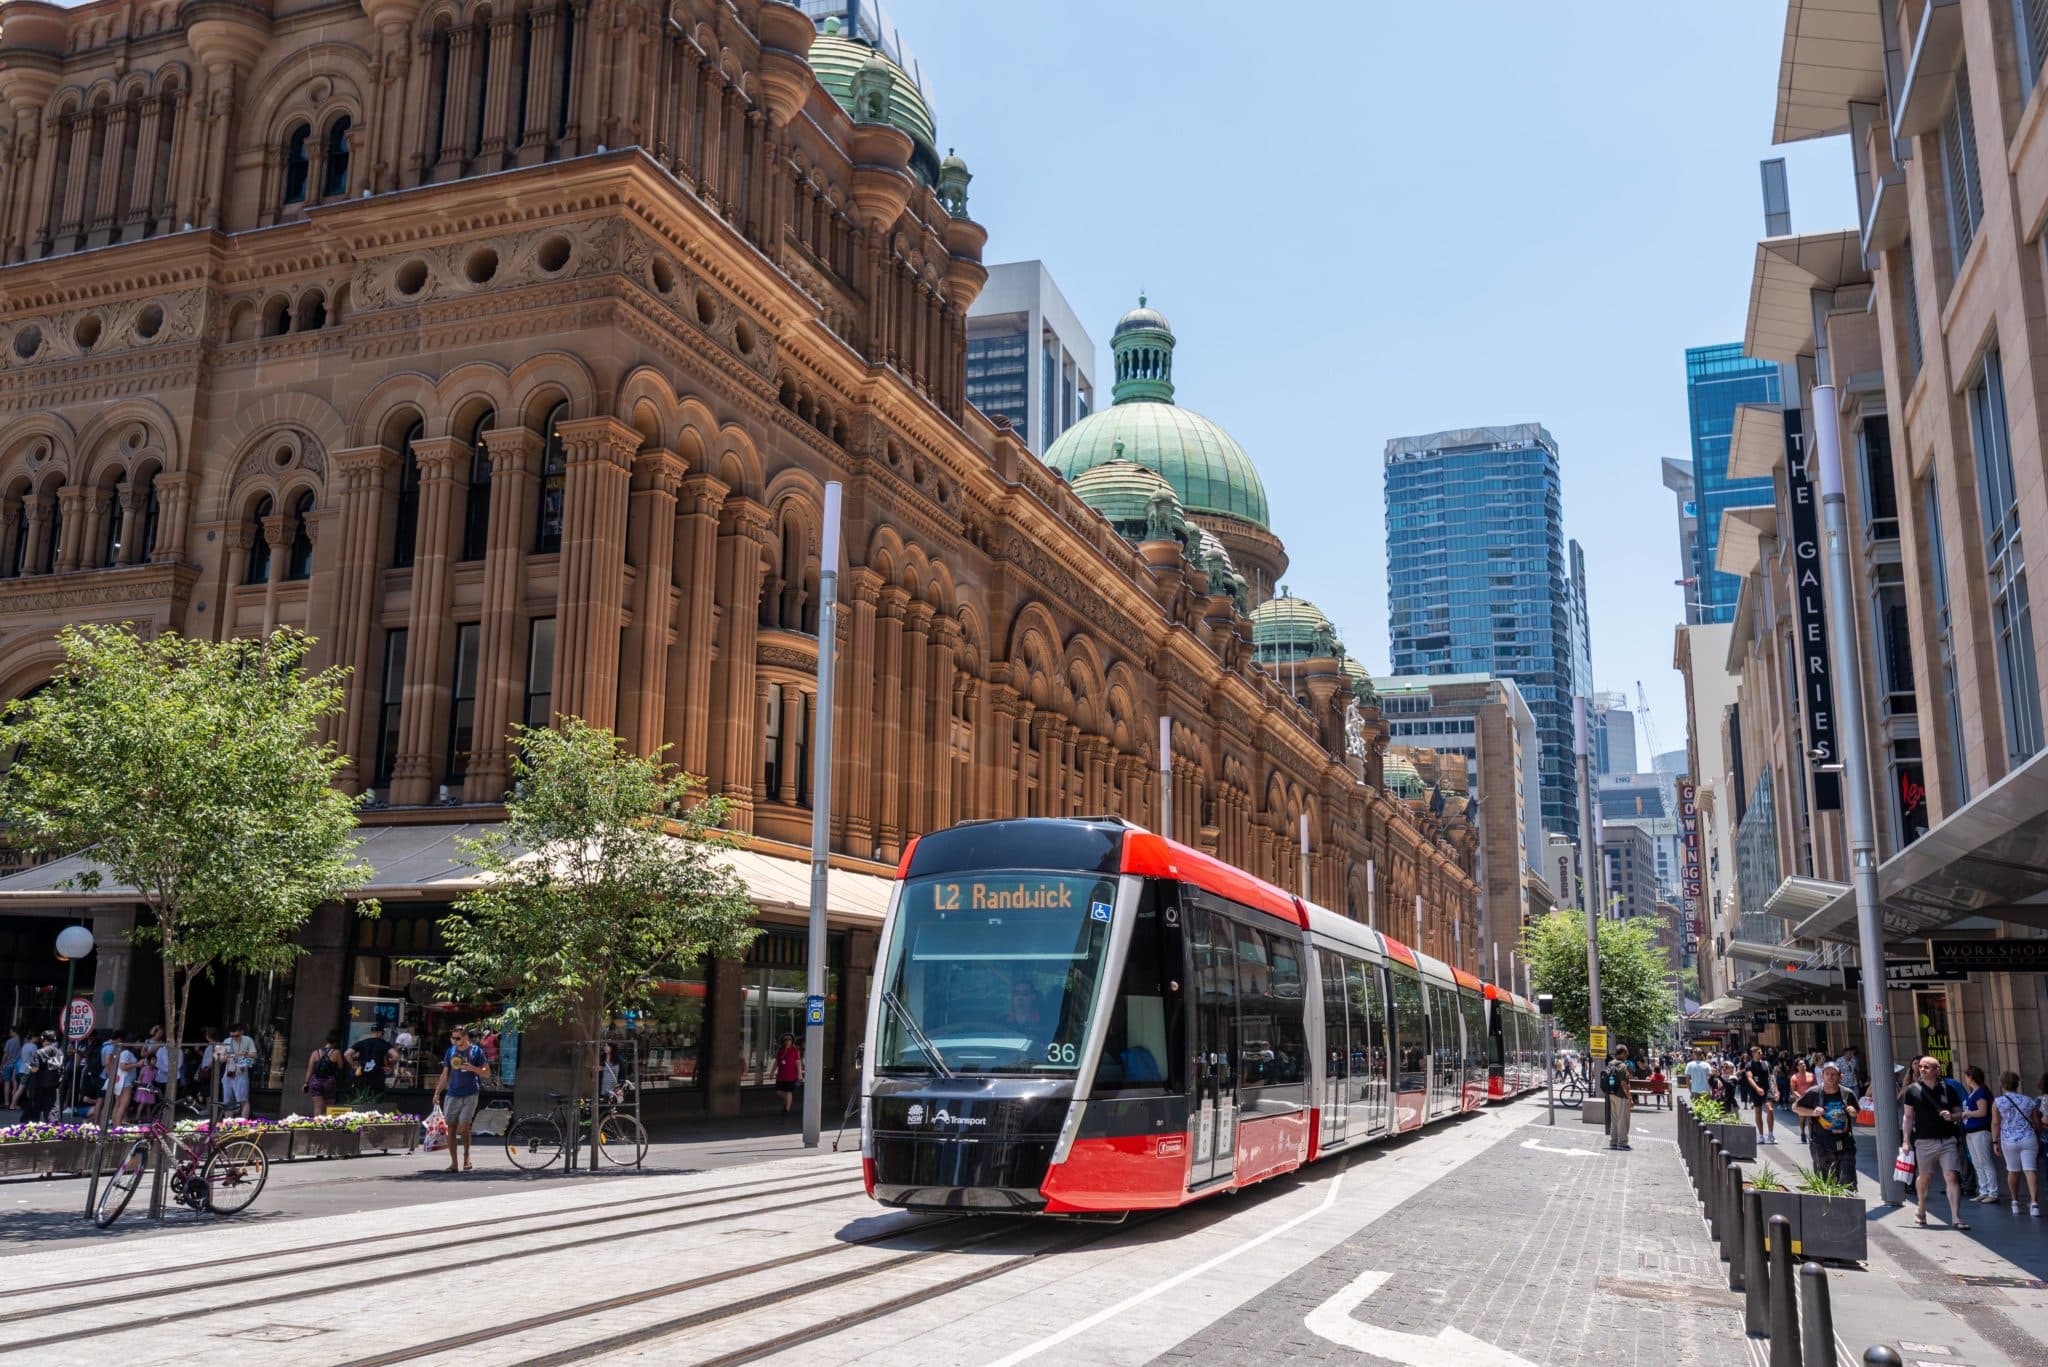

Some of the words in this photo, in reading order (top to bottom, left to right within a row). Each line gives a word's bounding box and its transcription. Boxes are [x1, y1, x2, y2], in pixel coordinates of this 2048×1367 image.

[1790, 433, 1809, 504] THE
[1797, 540, 1831, 760] GALERIES
[1683, 787, 1701, 895] GOWINGS
[934, 884, 960, 910] L2
[972, 882, 1072, 909] Randwick
[1943, 944, 2047, 957] WORKSHOP
[1794, 1009, 1842, 1017] CRUMPLER
[1928, 1035, 1943, 1048] ALL
[1047, 1042, 1076, 1063] 36
[907, 1115, 923, 1123] NSW
[950, 1115, 986, 1126] Transport
